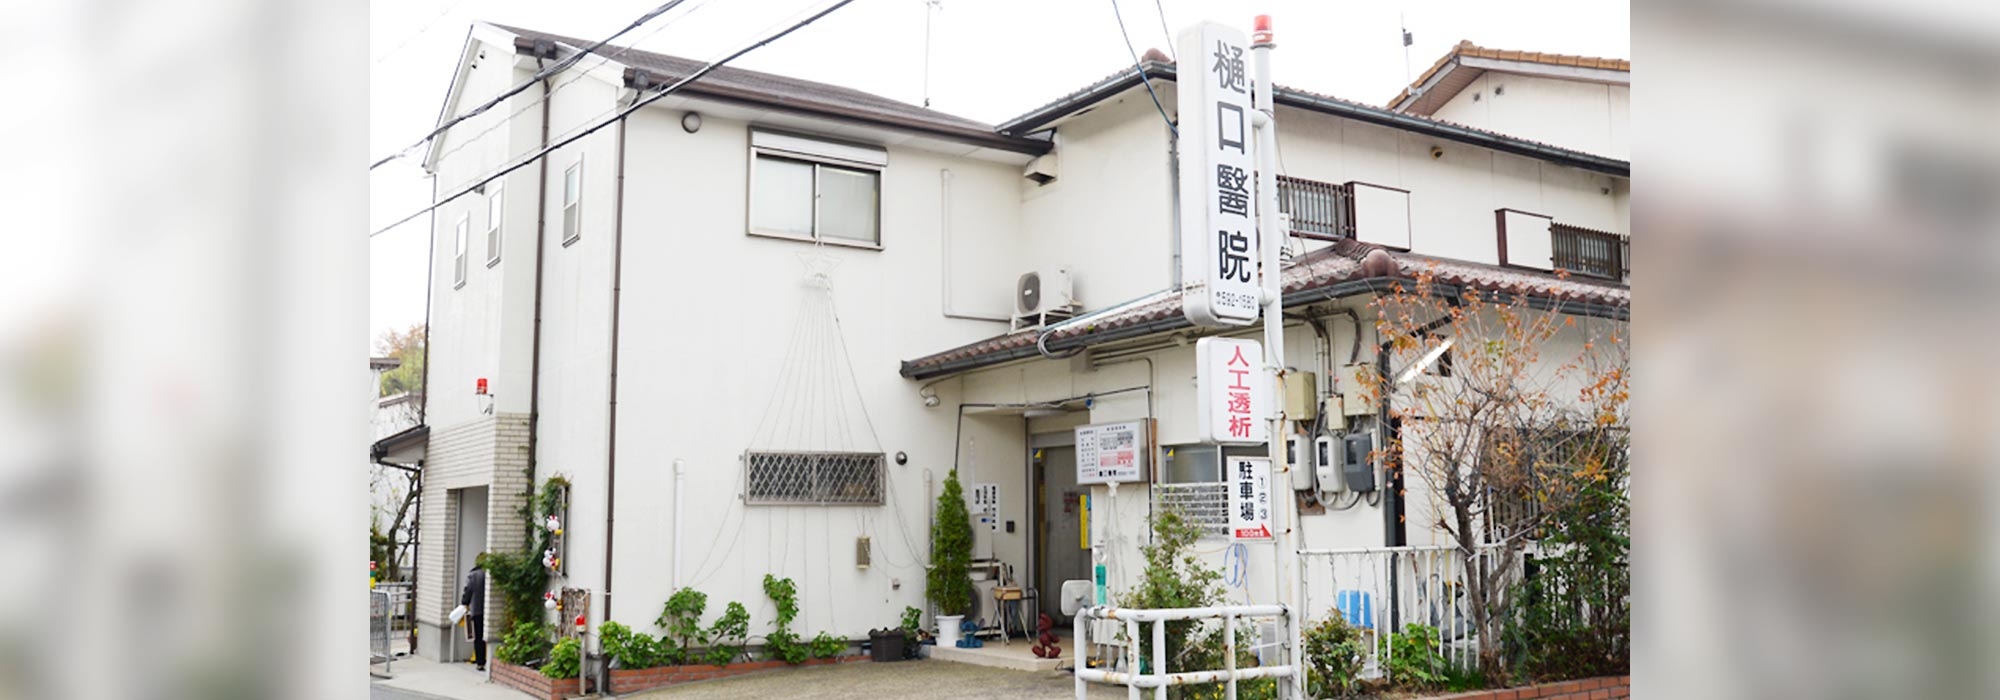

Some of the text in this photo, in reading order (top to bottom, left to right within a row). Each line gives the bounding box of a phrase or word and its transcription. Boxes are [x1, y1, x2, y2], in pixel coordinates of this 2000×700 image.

[1213, 39, 1250, 283] 樋口醫院
[1228, 345, 1252, 438] 人工透析
[1238, 461, 1254, 521] 駐車場
